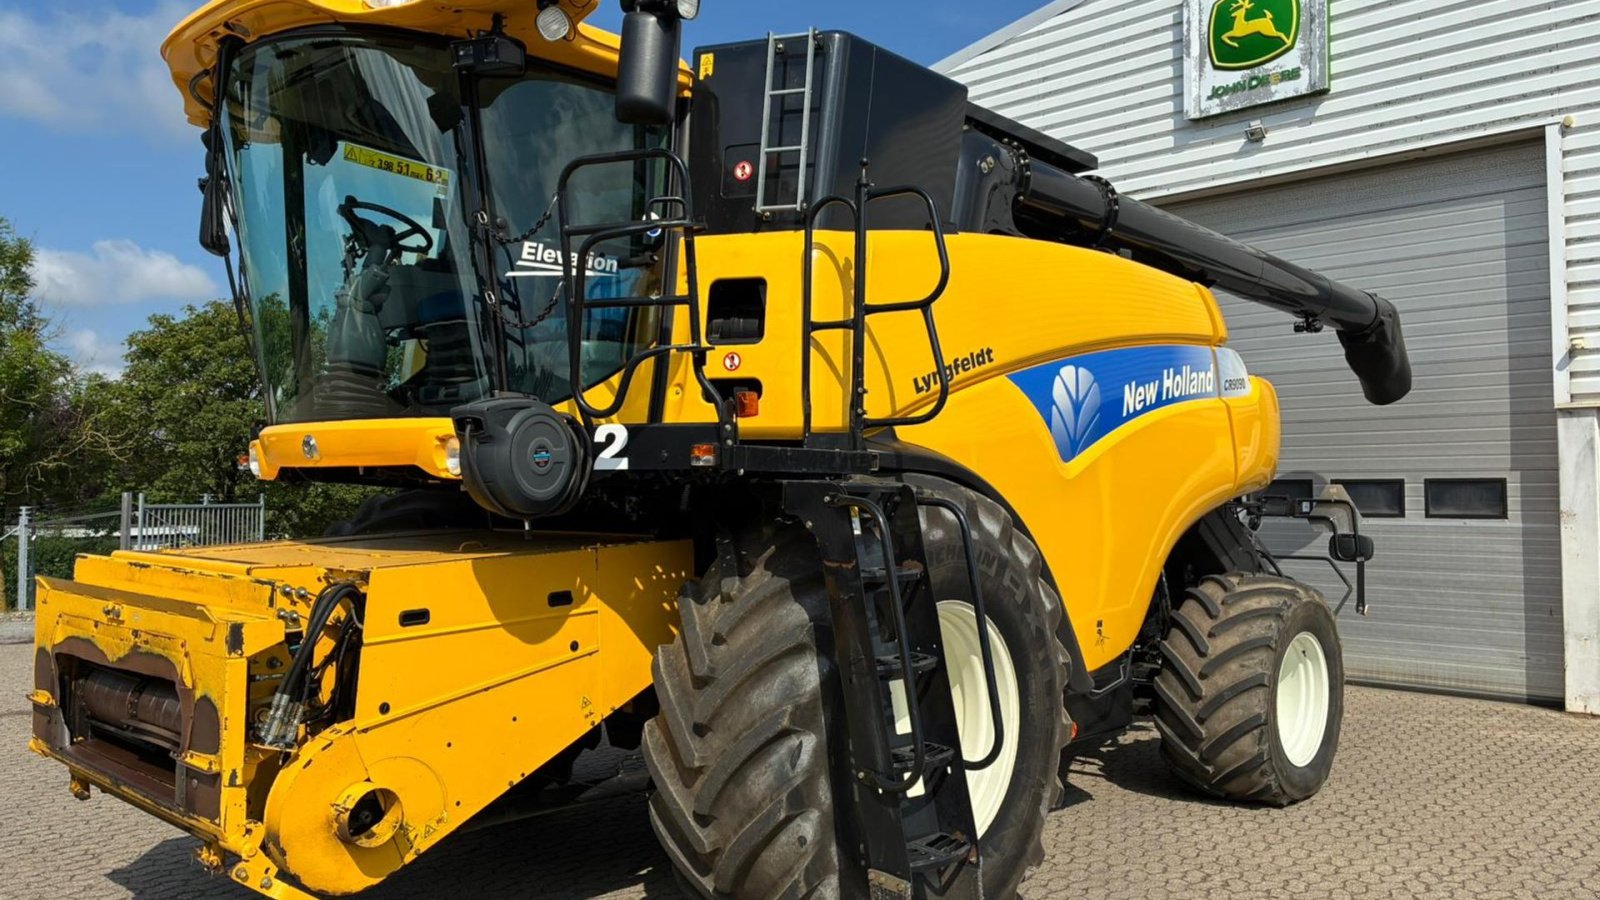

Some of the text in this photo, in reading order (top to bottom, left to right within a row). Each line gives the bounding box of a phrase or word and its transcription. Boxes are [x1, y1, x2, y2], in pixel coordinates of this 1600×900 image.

[1206, 66, 1302, 101] JOHN DEERE
[521, 241, 618, 273] Elevaion
[913, 347, 994, 394] Lyngfeldt
[1122, 363, 1214, 417] New Holland
[1223, 378, 1246, 392] CR9090
[593, 423, 629, 470] 2
